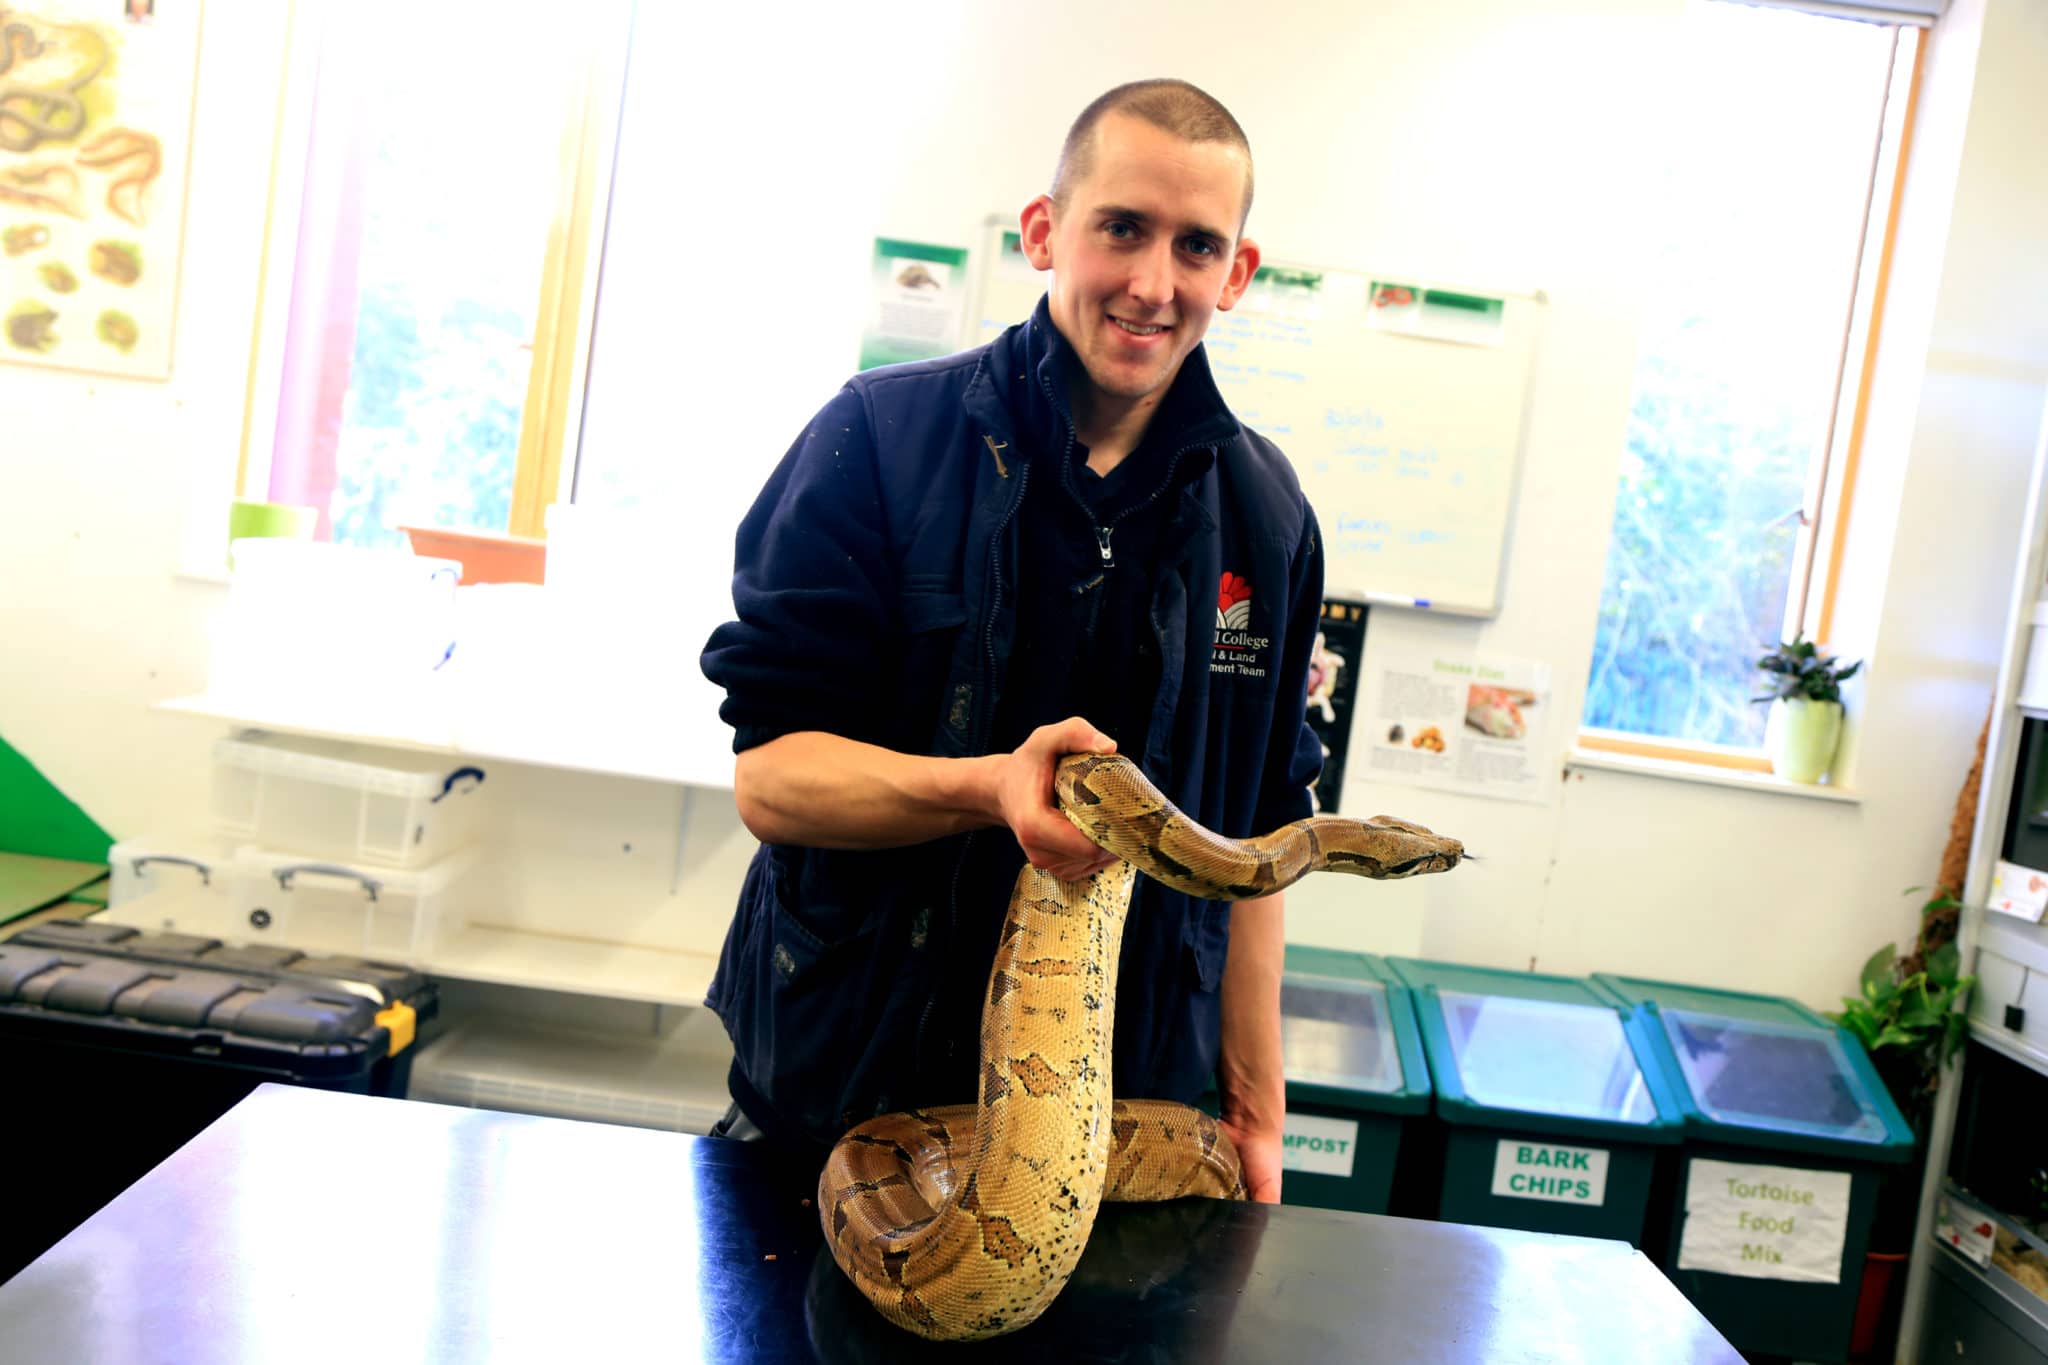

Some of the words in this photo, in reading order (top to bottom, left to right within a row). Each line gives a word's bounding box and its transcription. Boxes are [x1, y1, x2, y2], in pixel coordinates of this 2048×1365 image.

[1222, 631, 1269, 649] College
[1218, 650, 1226, 660] &
[1229, 651, 1256, 663] Land
[1209, 663, 1235, 673] ment
[1237, 664, 1265, 677] Team
[1283, 1134, 1349, 1155] MPOST
[1517, 1146, 1590, 1171] BARK
[1509, 1173, 1590, 1199] CHIPS
[1726, 1178, 1815, 1206] Tortoise
[1737, 1210, 1794, 1235] Food
[1742, 1243, 1783, 1264] Mix
